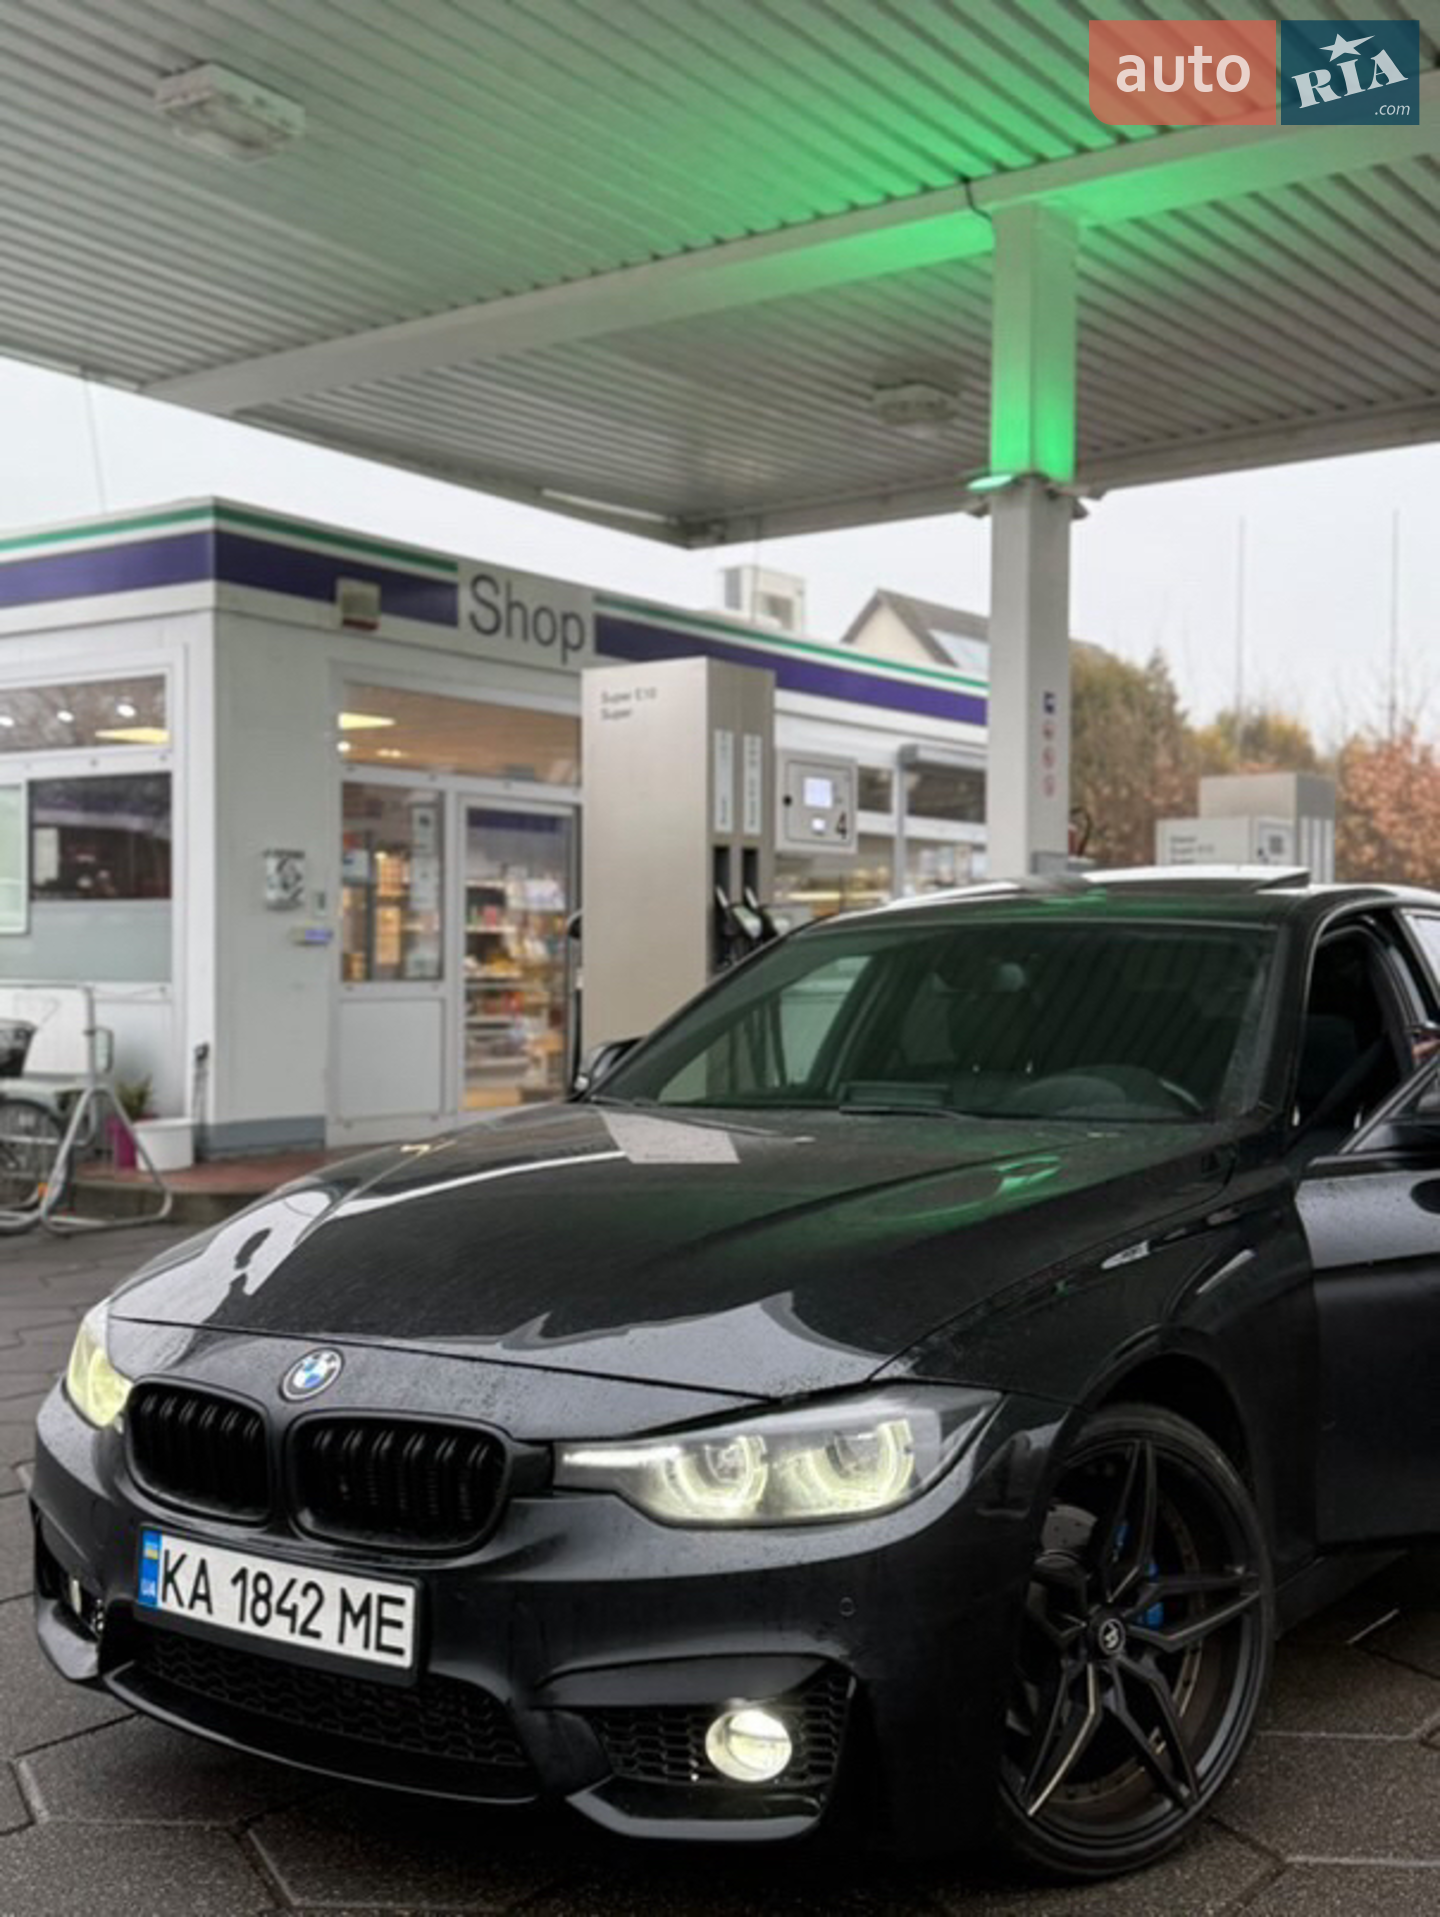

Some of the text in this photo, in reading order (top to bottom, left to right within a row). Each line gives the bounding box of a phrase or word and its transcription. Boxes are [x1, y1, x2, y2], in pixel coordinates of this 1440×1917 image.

[469, 573, 585, 667] Shop
[835, 811, 848, 840] 4
[161, 1548, 406, 1657] KA 1842 ME
